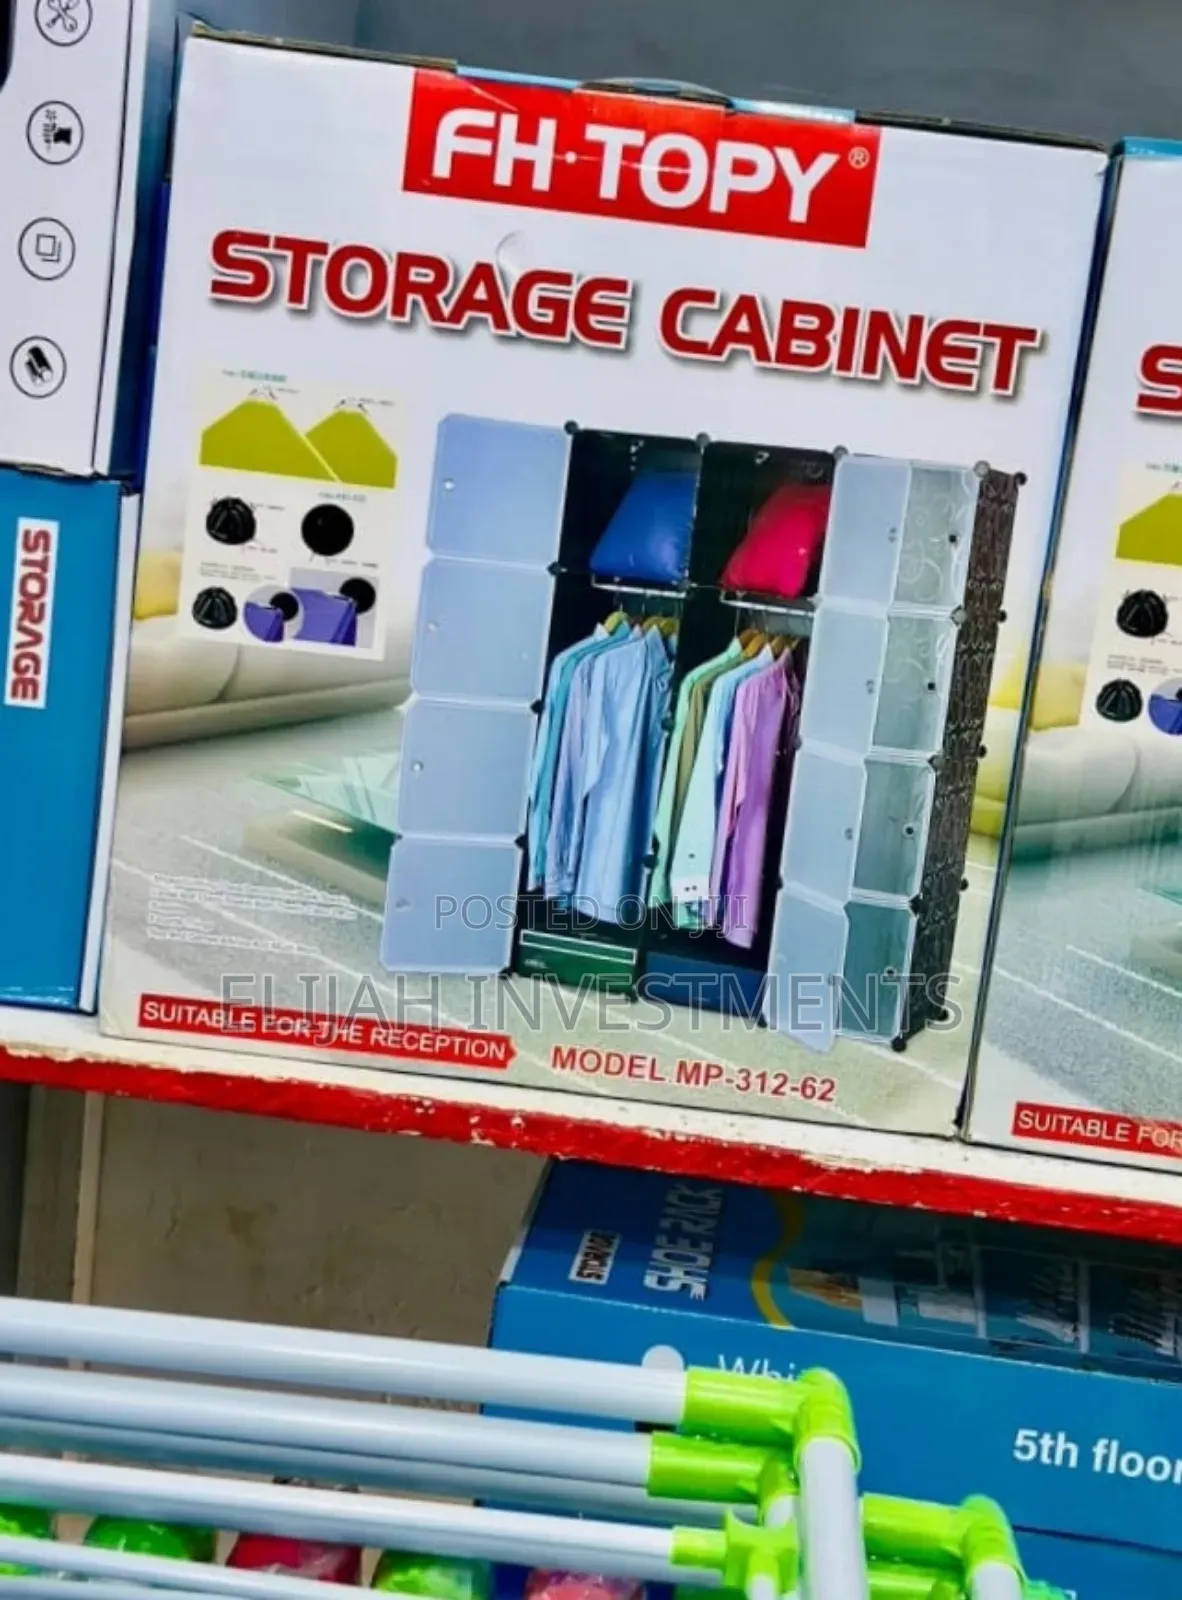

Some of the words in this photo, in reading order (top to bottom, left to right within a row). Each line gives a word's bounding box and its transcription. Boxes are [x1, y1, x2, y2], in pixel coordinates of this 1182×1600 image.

[209, 229, 629, 348] STORAGE
[658, 287, 1040, 395] CABINET
[10, 528, 52, 700] STORAGE
[142, 1000, 257, 1032] SUITABLE
[261, 1012, 312, 1038] FOR
[312, 1018, 363, 1045] THE
[369, 1026, 507, 1061] RECEPTION
[551, 1045, 666, 1082] MODEL
[674, 1059, 837, 1102] MP-312-62
[1017, 1109, 1132, 1143] SUITABLE
[643, 1233, 714, 1302] SHOE
[1013, 1427, 1079, 1468] 5th
